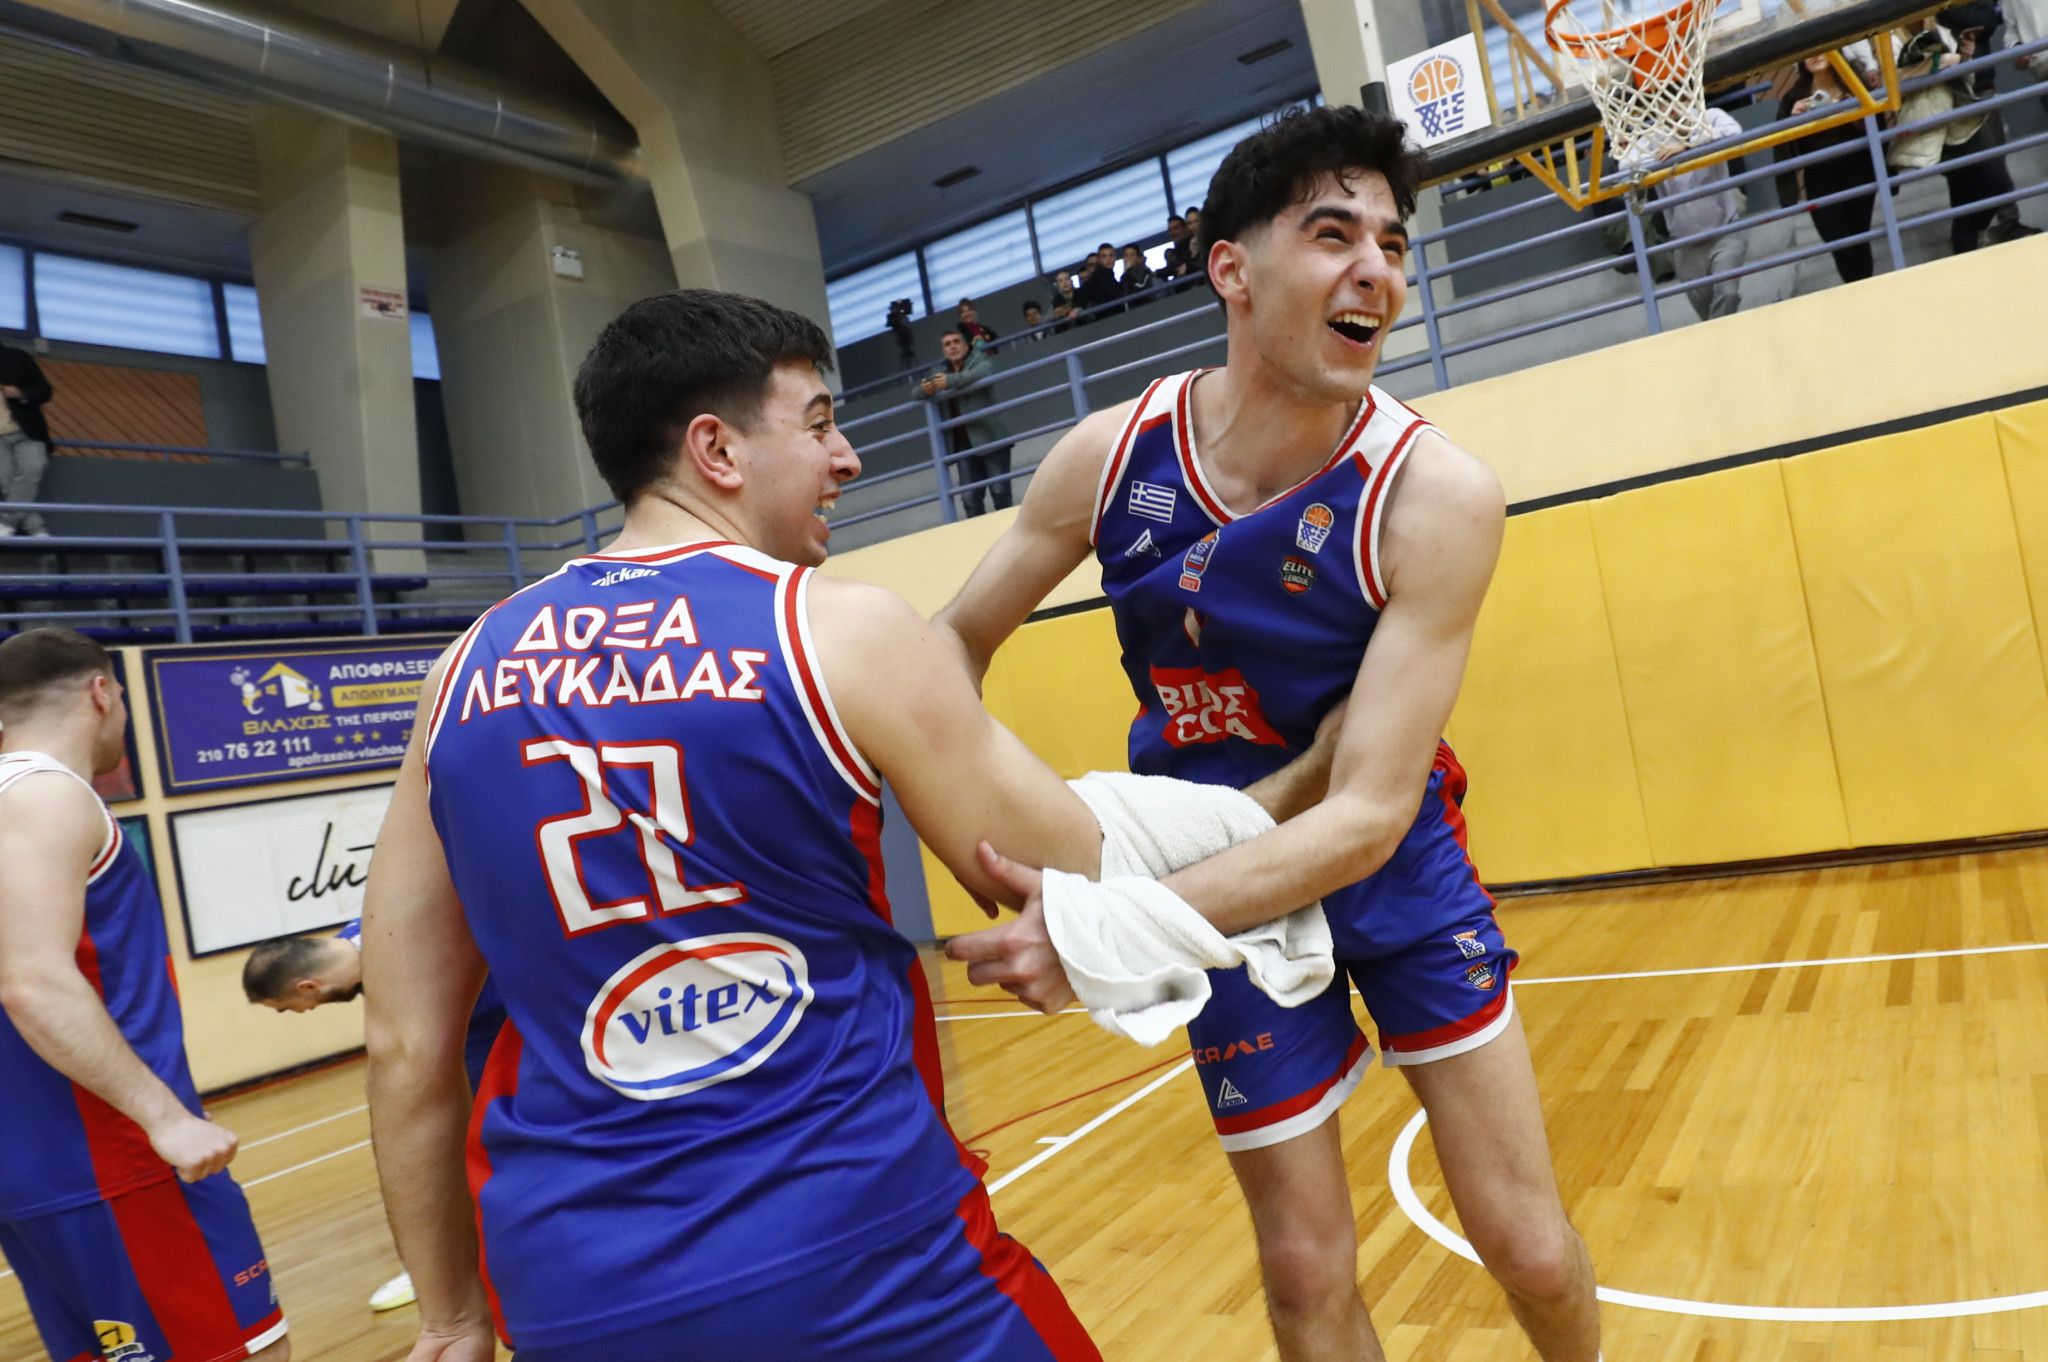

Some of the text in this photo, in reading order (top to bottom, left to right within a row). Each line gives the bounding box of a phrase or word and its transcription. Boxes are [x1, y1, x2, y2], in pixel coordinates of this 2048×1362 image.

[1283, 561, 1315, 579] ELITE
[511, 595, 700, 653] ΔΟΞΑ
[329, 659, 437, 680] ΑΠΟΦΡΑΞΕΙ
[459, 649, 769, 724] ΛΕΥΚΑΔΑΣ
[335, 714, 362, 727] ΤΗΣ
[197, 736, 311, 763] 210 76 22 111
[519, 735, 751, 939] 22
[617, 979, 780, 1044] vitex
